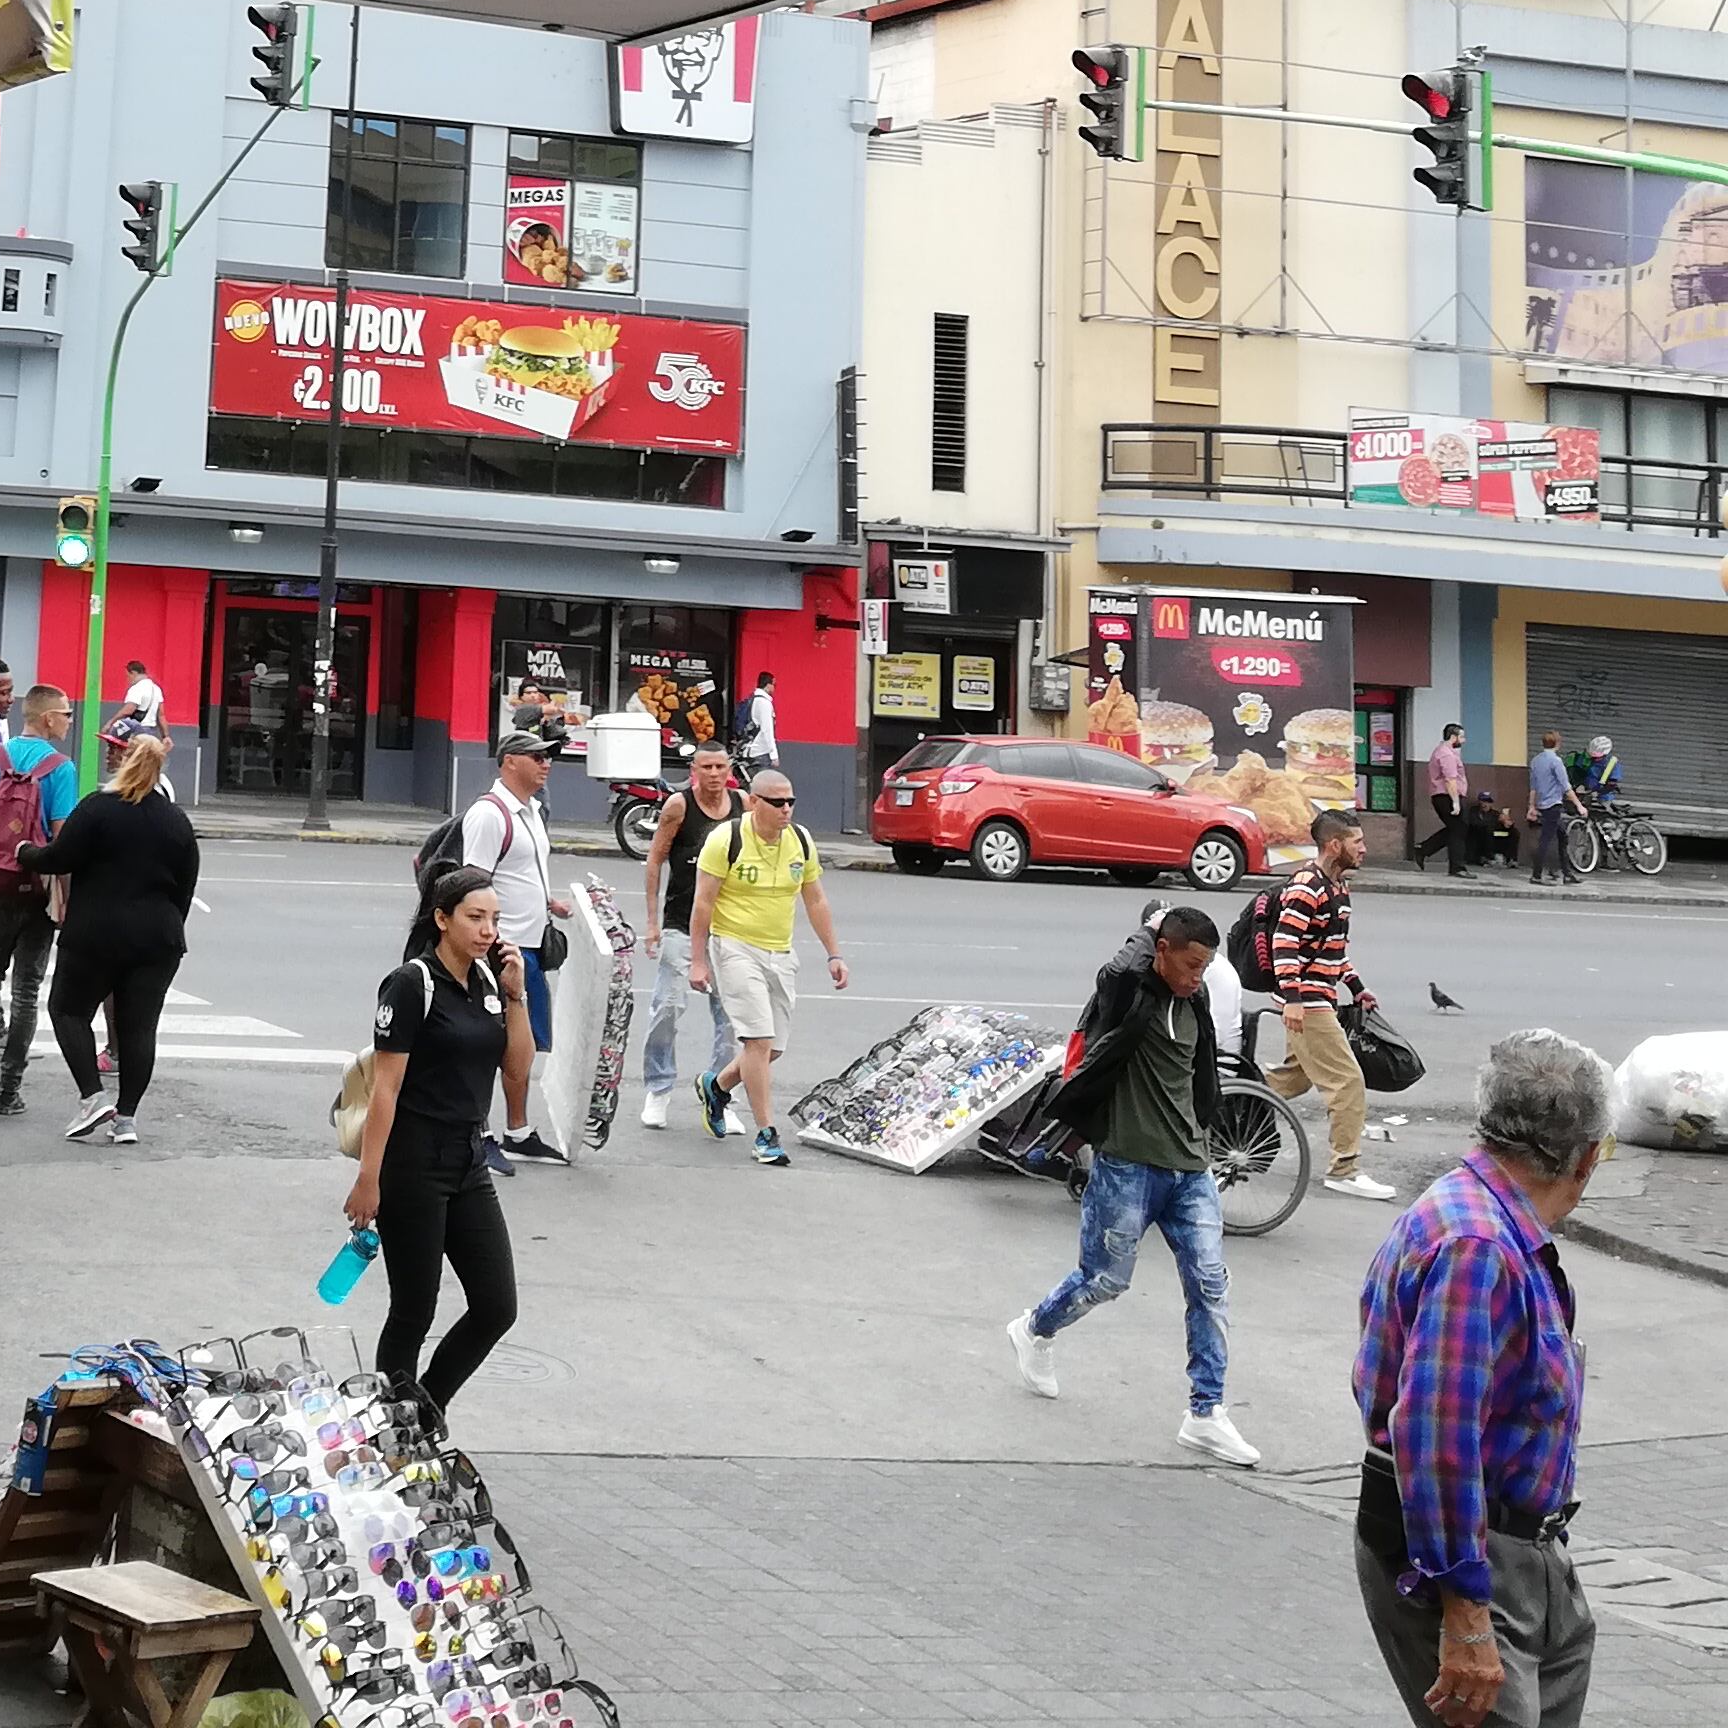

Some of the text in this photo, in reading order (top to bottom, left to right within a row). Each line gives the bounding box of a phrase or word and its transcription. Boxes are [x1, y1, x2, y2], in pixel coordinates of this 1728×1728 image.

[509, 189, 564, 204] MEGAS
[224, 311, 270, 331] NUEVO
[688, 378, 725, 396] KFC
[493, 393, 526, 413] KFC
[1197, 607, 1324, 642] McMenú
[630, 653, 672, 668] MEGA
